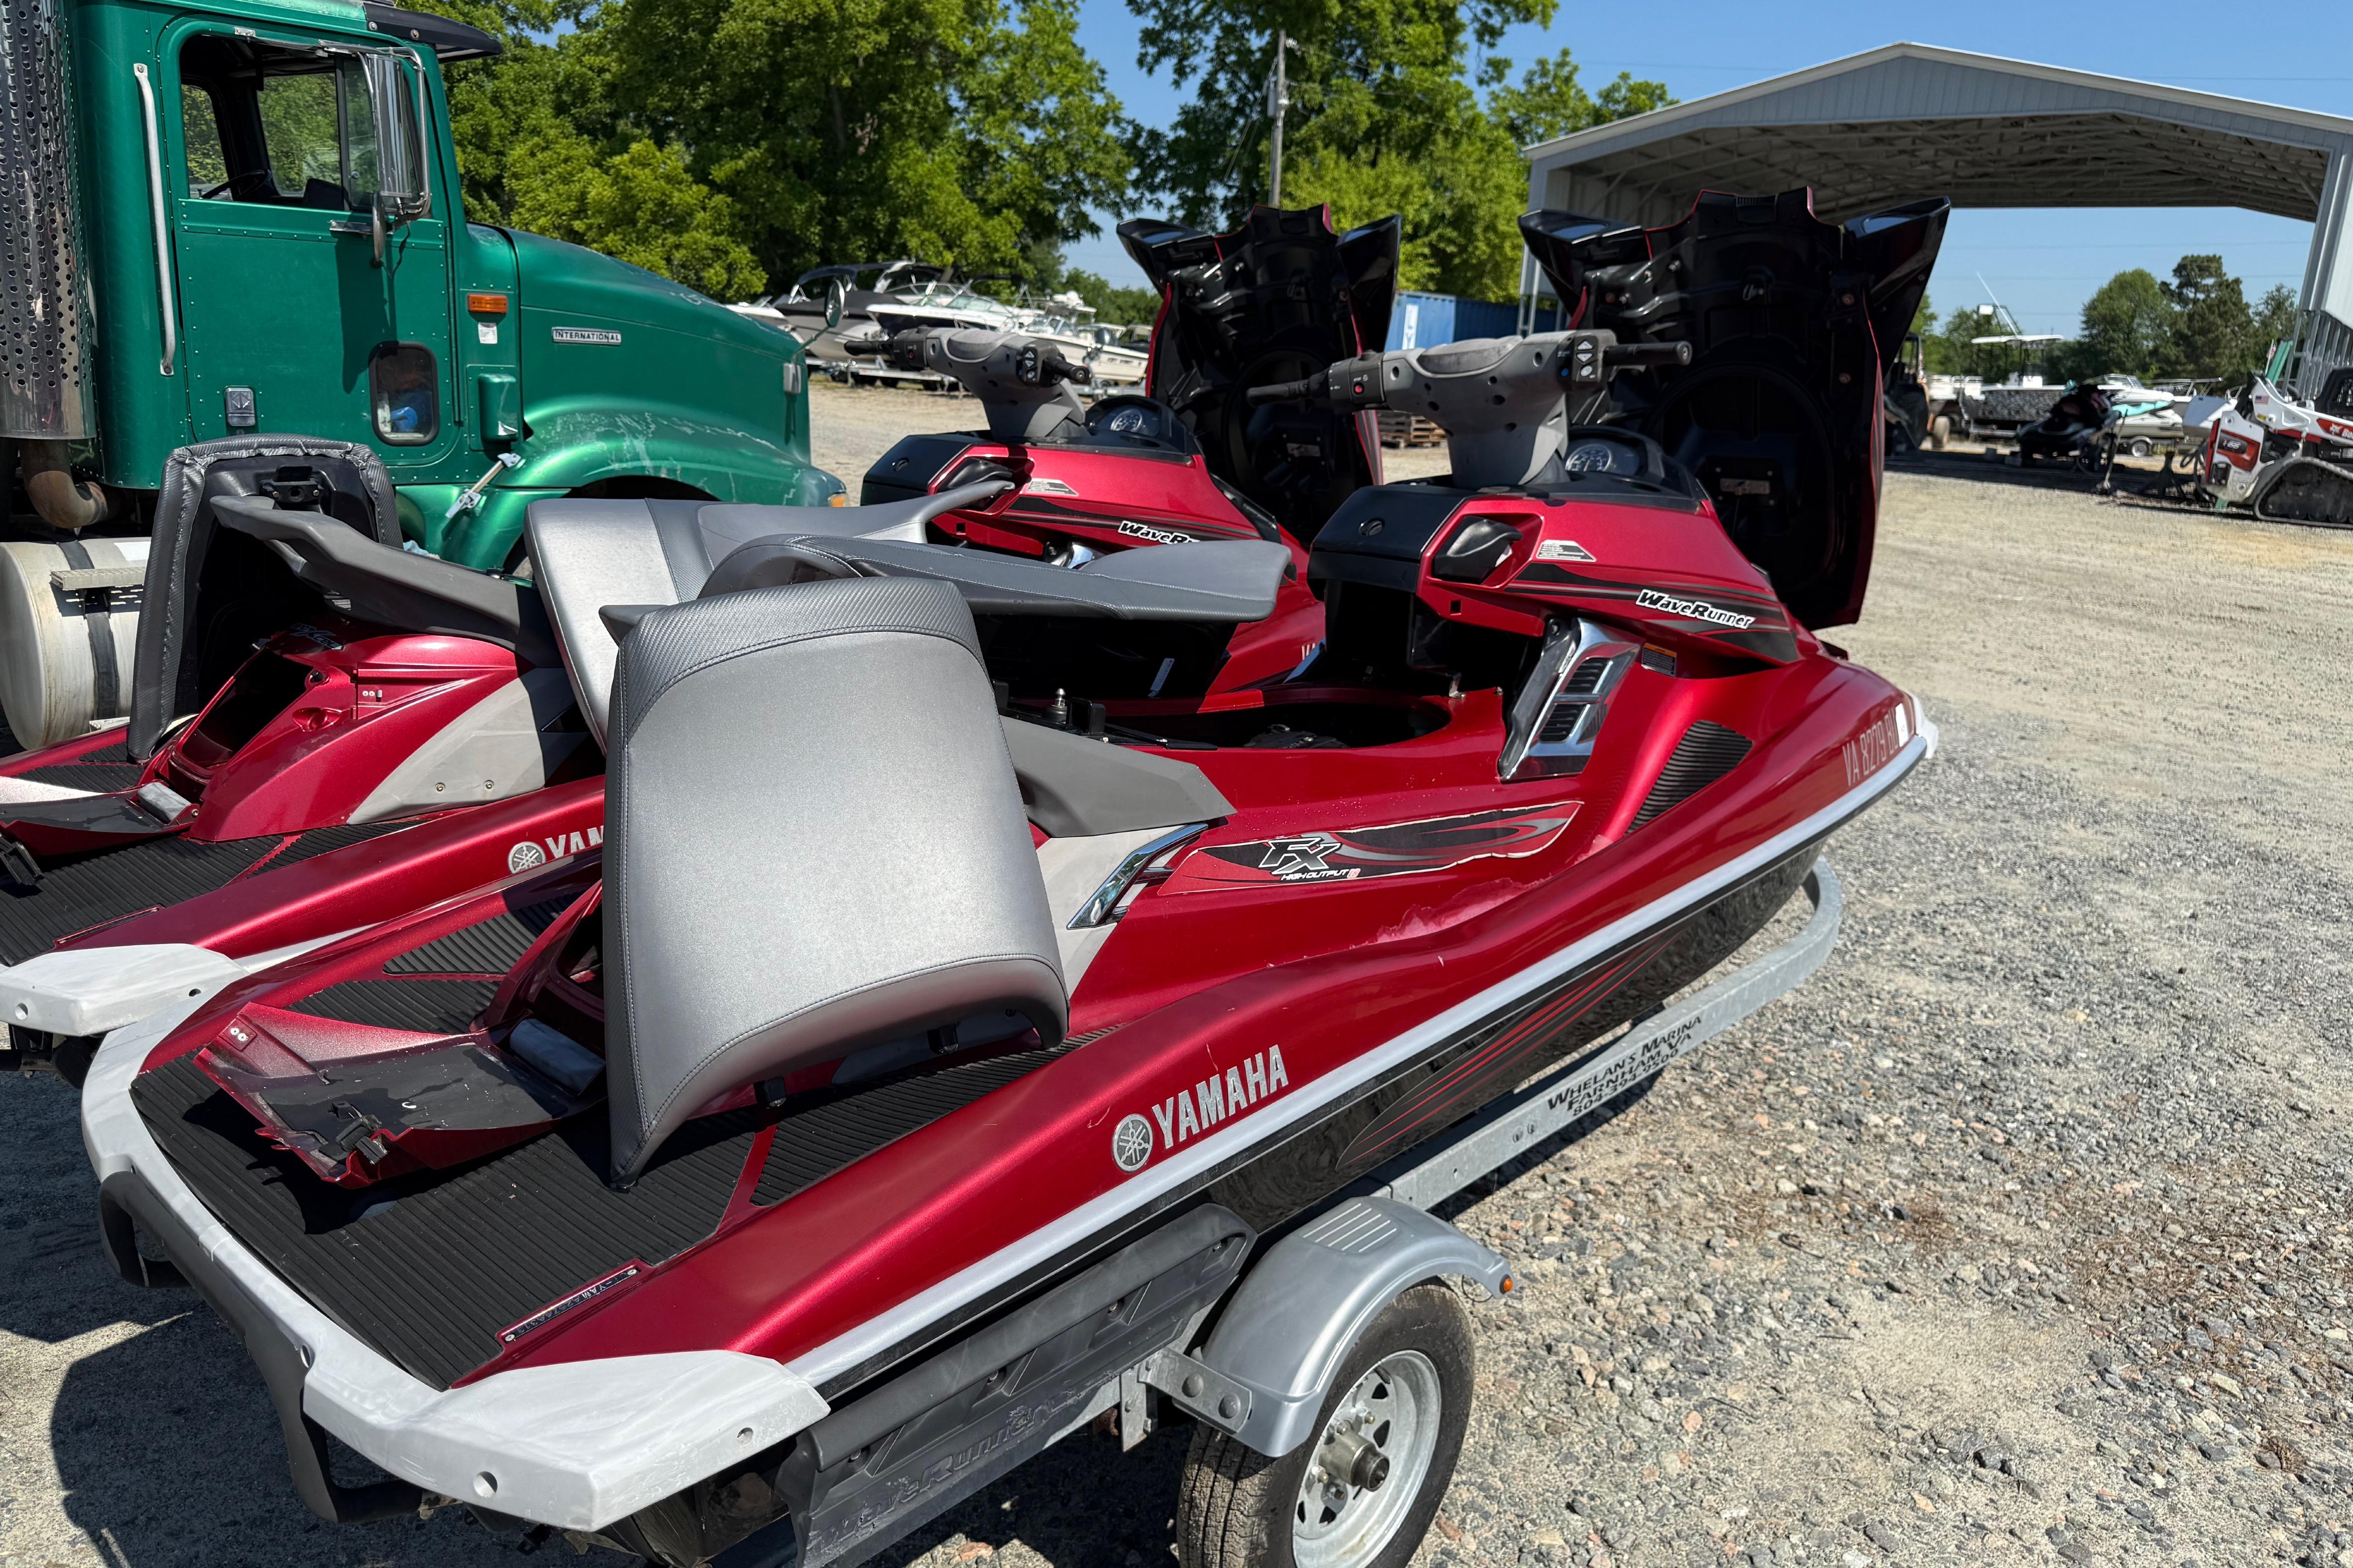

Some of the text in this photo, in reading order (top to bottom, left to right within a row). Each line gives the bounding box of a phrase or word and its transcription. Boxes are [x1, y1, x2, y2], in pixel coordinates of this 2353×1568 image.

[555, 330, 619, 341] INTERNATIONAL
[1118, 520, 1200, 544] WaveR
[1636, 589, 1756, 629] WaveRunner
[1842, 740, 1859, 787] VA
[1859, 721, 1887, 776] 8279
[1258, 837, 1342, 876] FX
[1667, 1033, 1691, 1051] VA
[1547, 1016, 1702, 1110] WHELAN'S MARINA
[1573, 1048, 1679, 1116] 804-394-9500
[1151, 1044, 1289, 1150] YAMAHA
